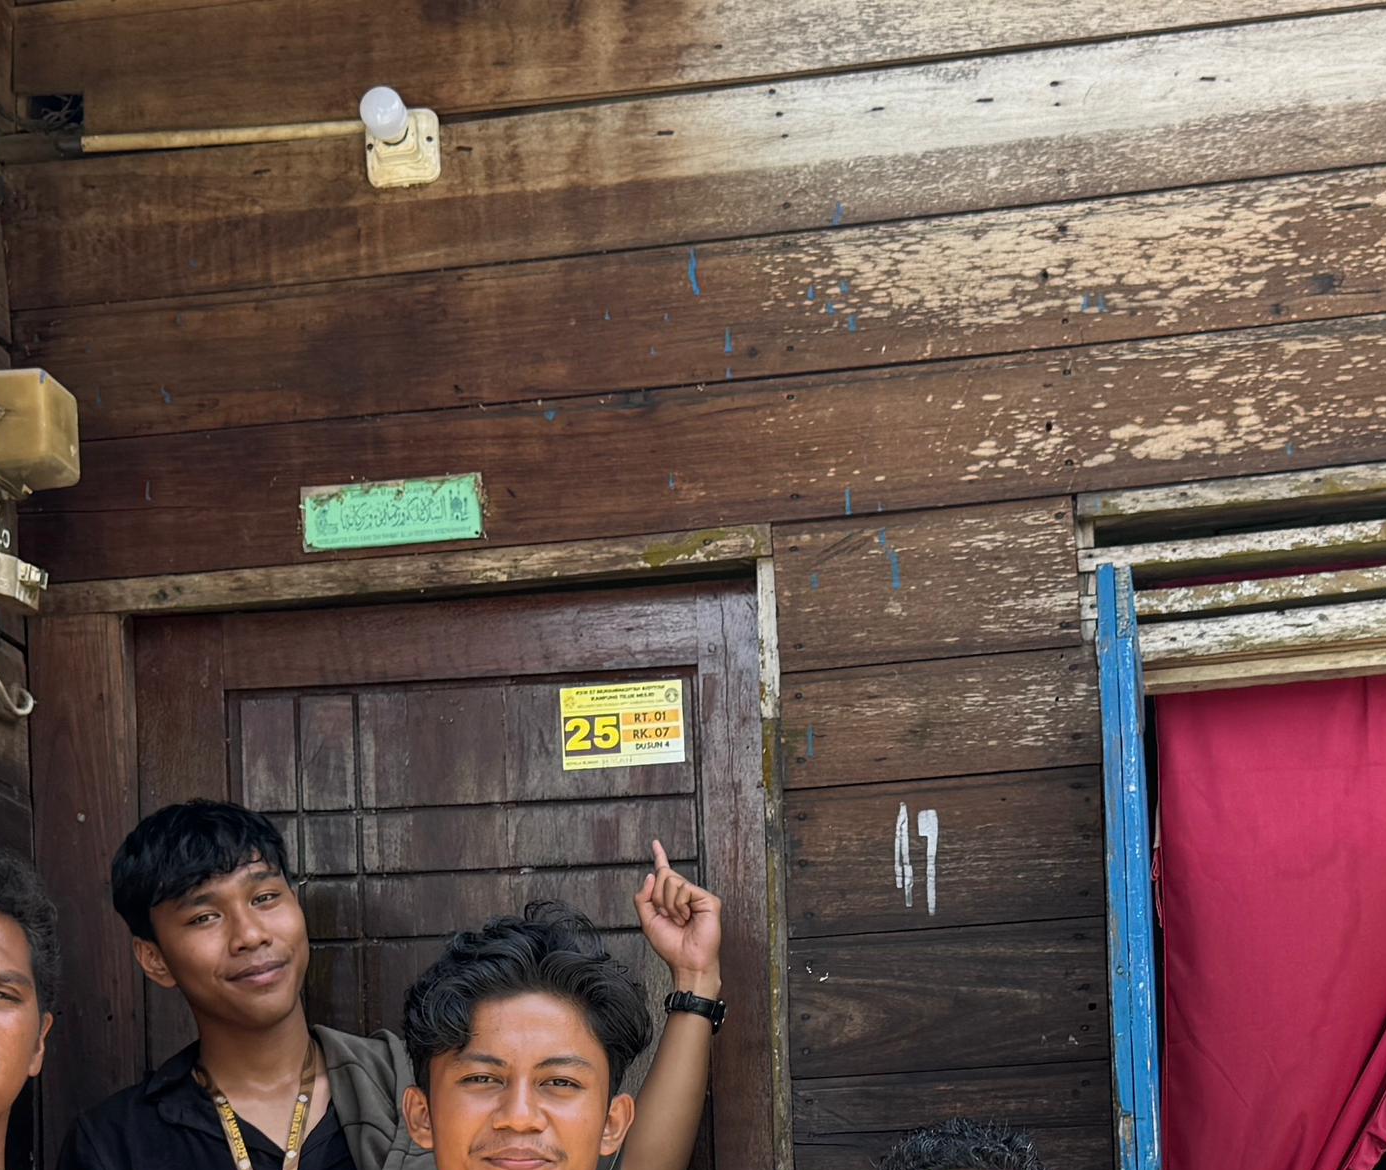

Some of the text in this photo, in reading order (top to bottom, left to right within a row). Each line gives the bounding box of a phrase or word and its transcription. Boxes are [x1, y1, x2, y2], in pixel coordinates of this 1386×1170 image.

[634, 711, 665, 722] RT. 01
[567, 716, 619, 751] 25
[632, 727, 669, 738] RK. 07
[635, 741, 662, 749] DUSUN
